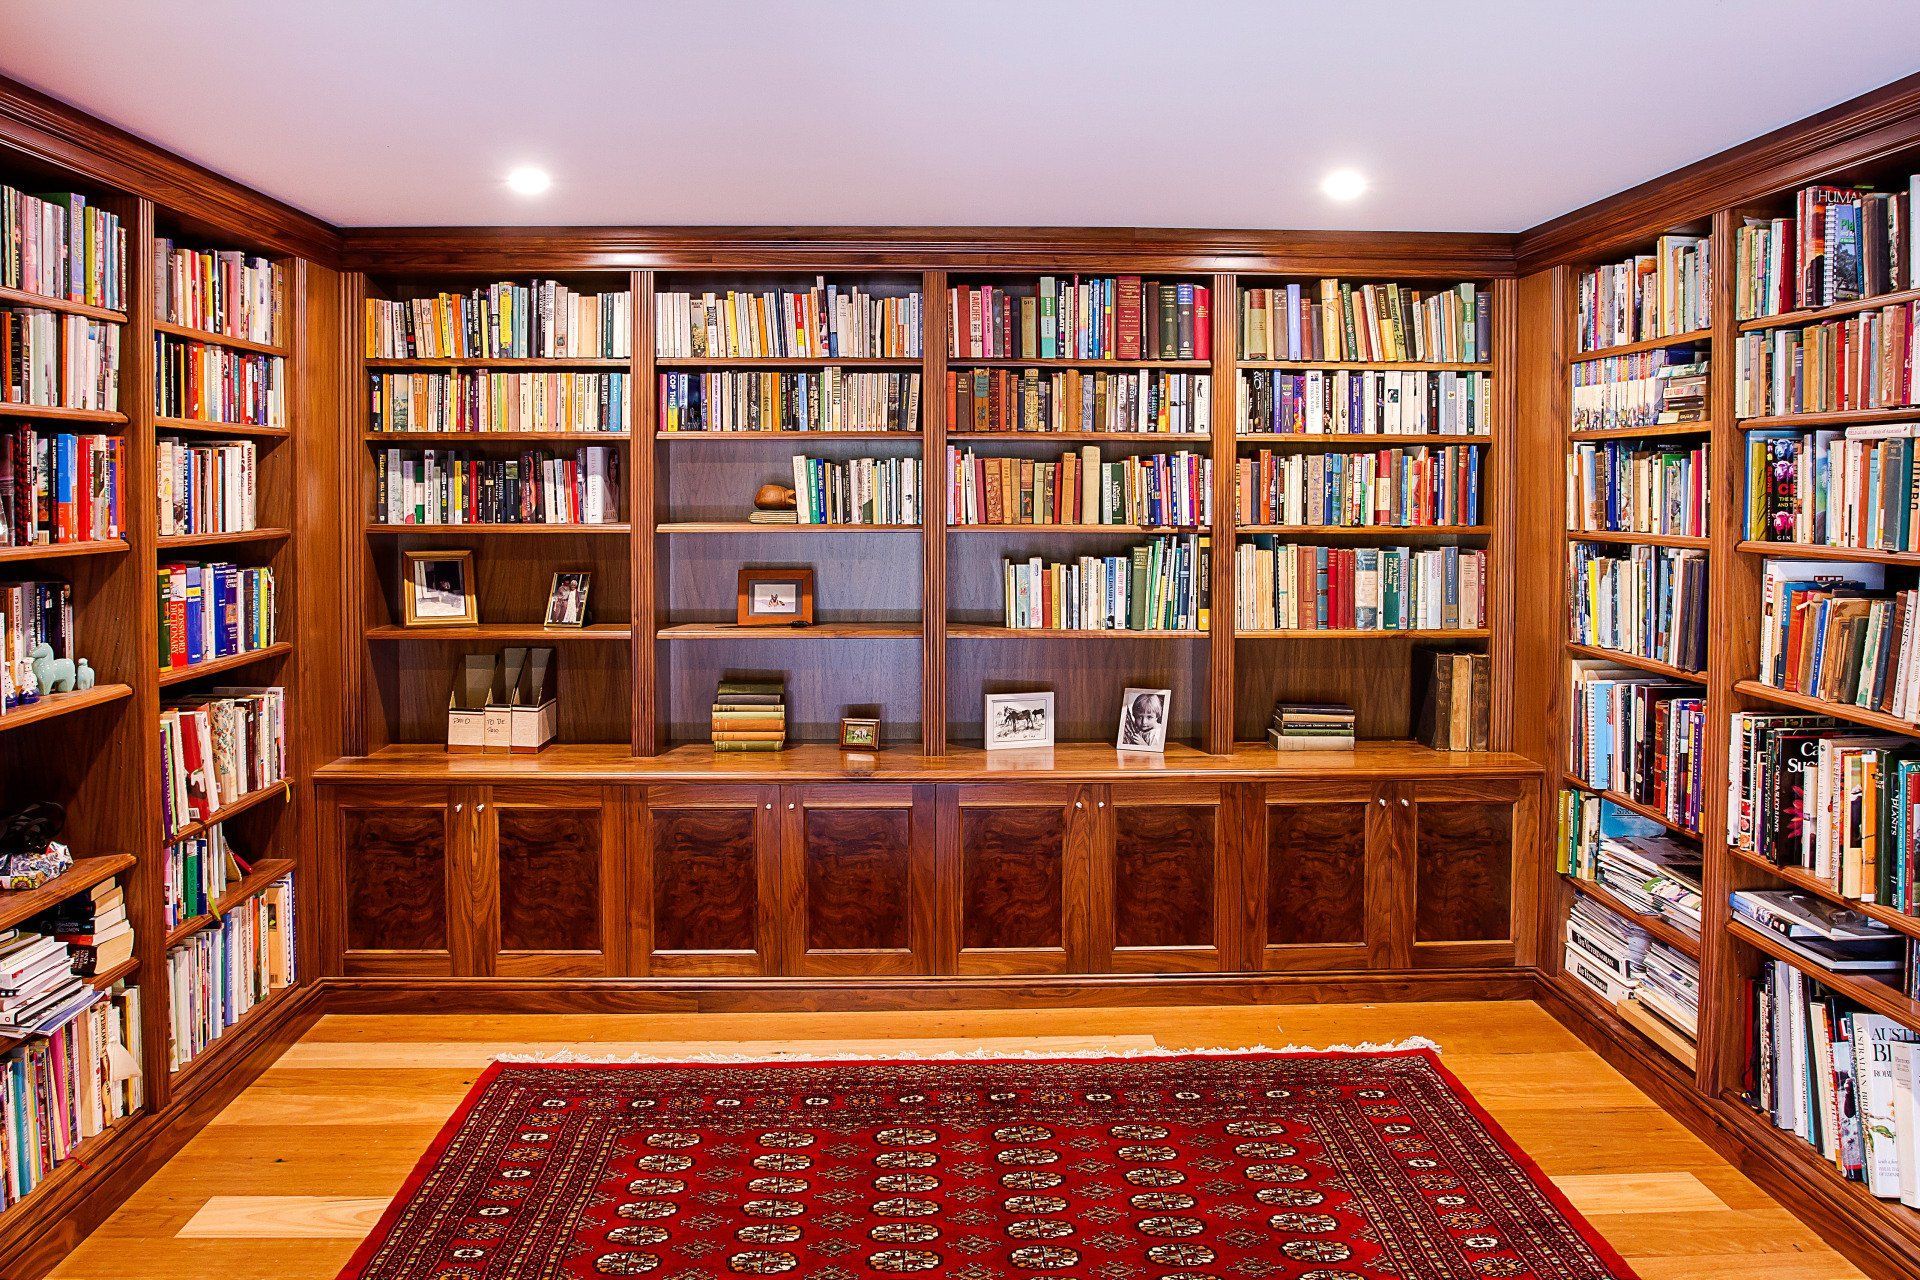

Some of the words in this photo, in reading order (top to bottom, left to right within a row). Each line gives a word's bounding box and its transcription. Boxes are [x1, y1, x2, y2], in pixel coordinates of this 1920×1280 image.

[669, 375, 678, 390] COP
[169, 603, 179, 656] DICTIONARY
[177, 603, 186, 654] CROSSWORD
[1901, 603, 1914, 648] HORSES
[1855, 1024, 1868, 1086] AUSTRALIAN
